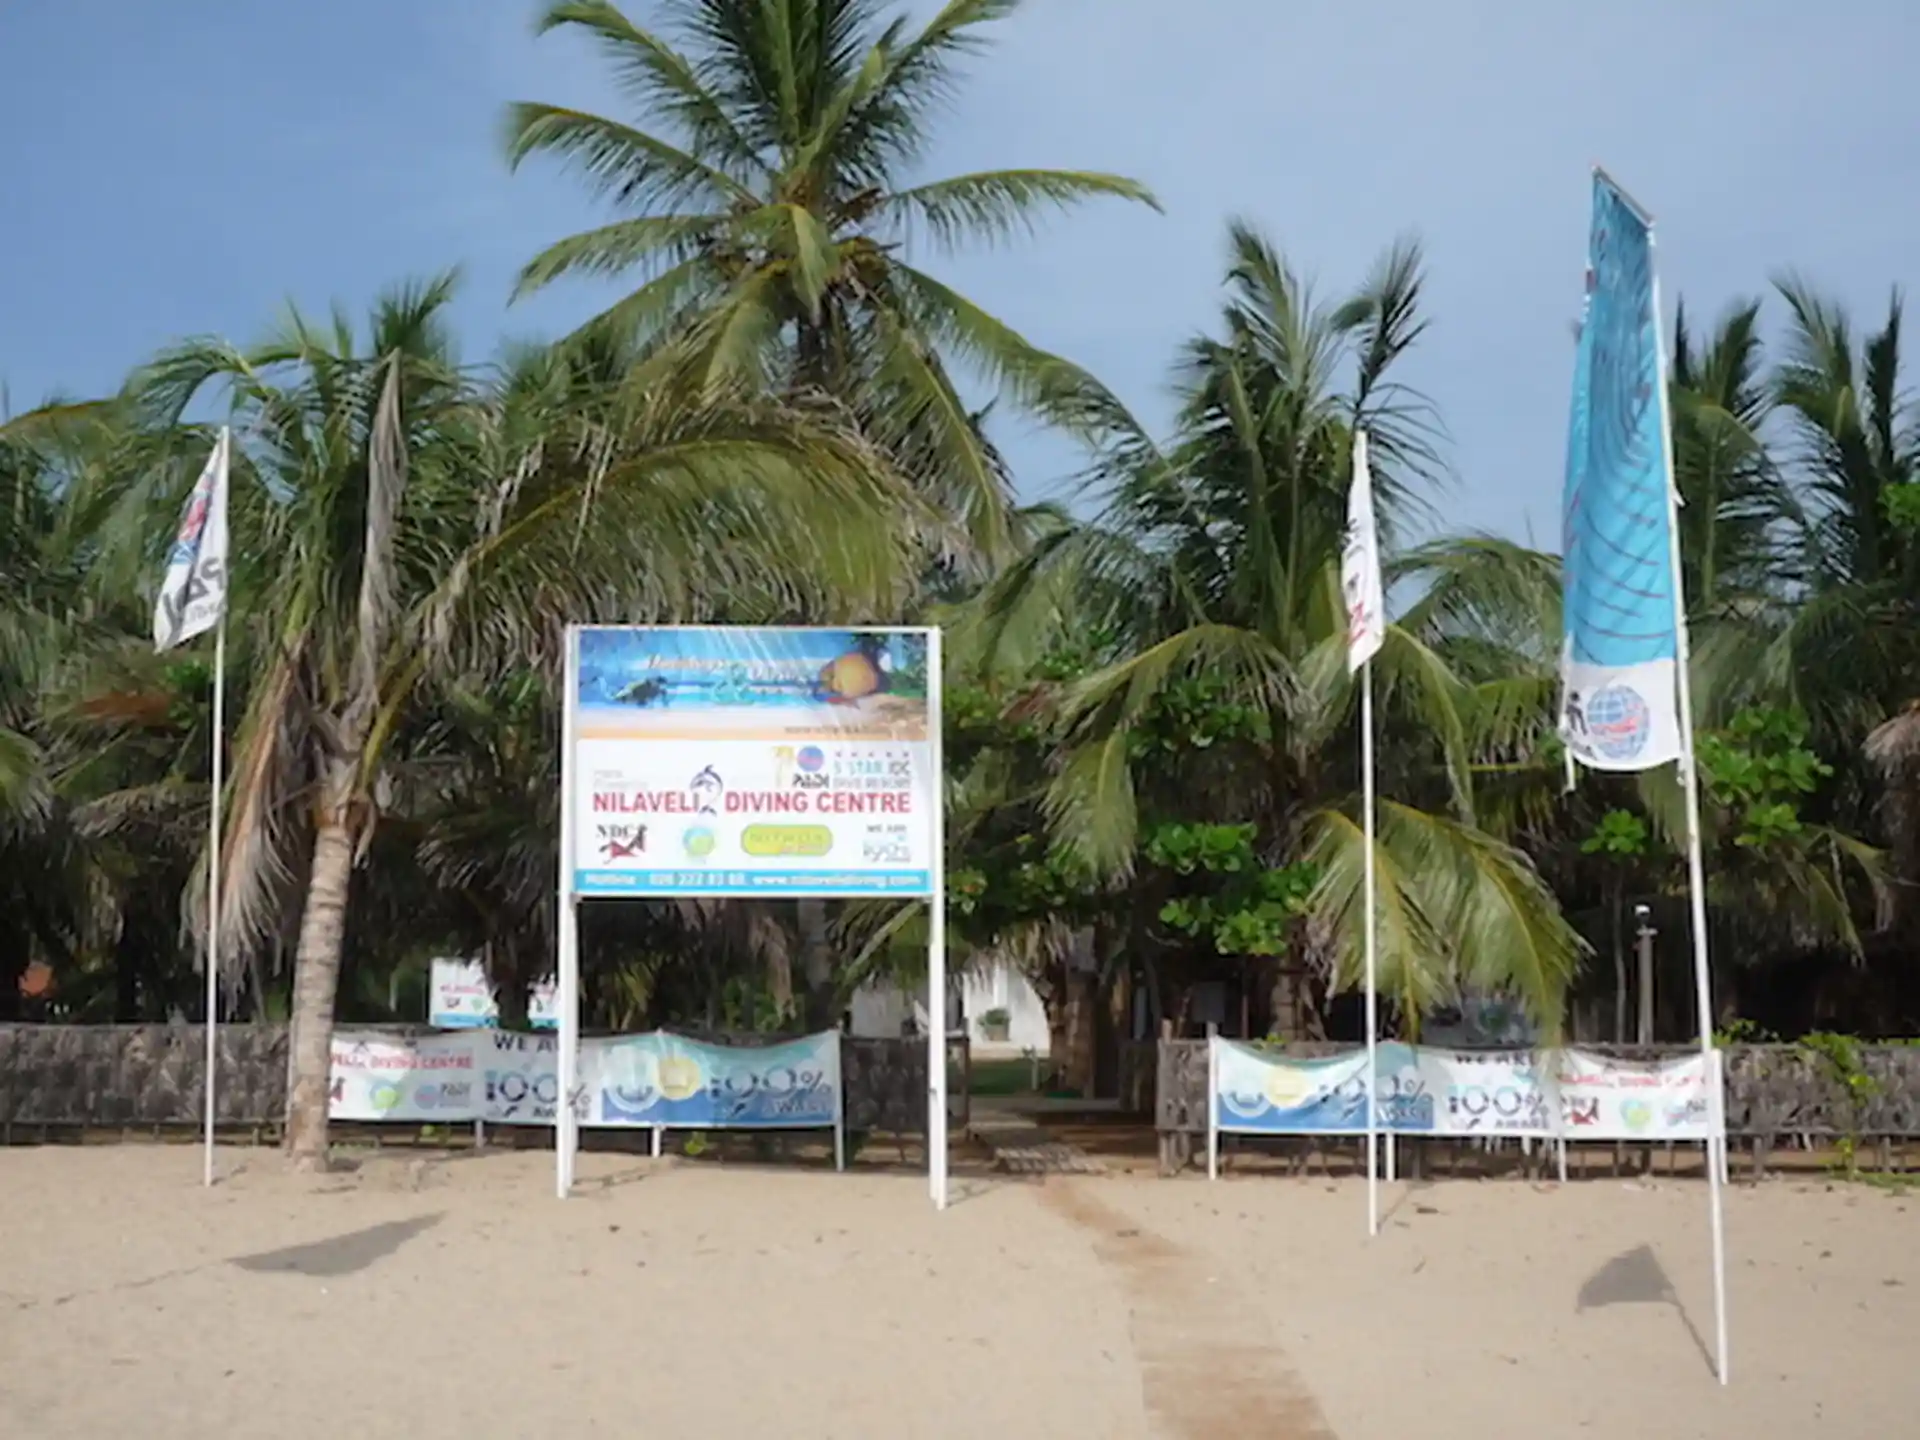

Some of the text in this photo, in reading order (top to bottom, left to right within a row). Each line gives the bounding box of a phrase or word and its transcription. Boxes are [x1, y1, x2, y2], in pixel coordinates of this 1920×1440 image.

[593, 791, 912, 813] NILAVELI DIVING CENTRE
[421, 1053, 474, 1070] CENTRE
